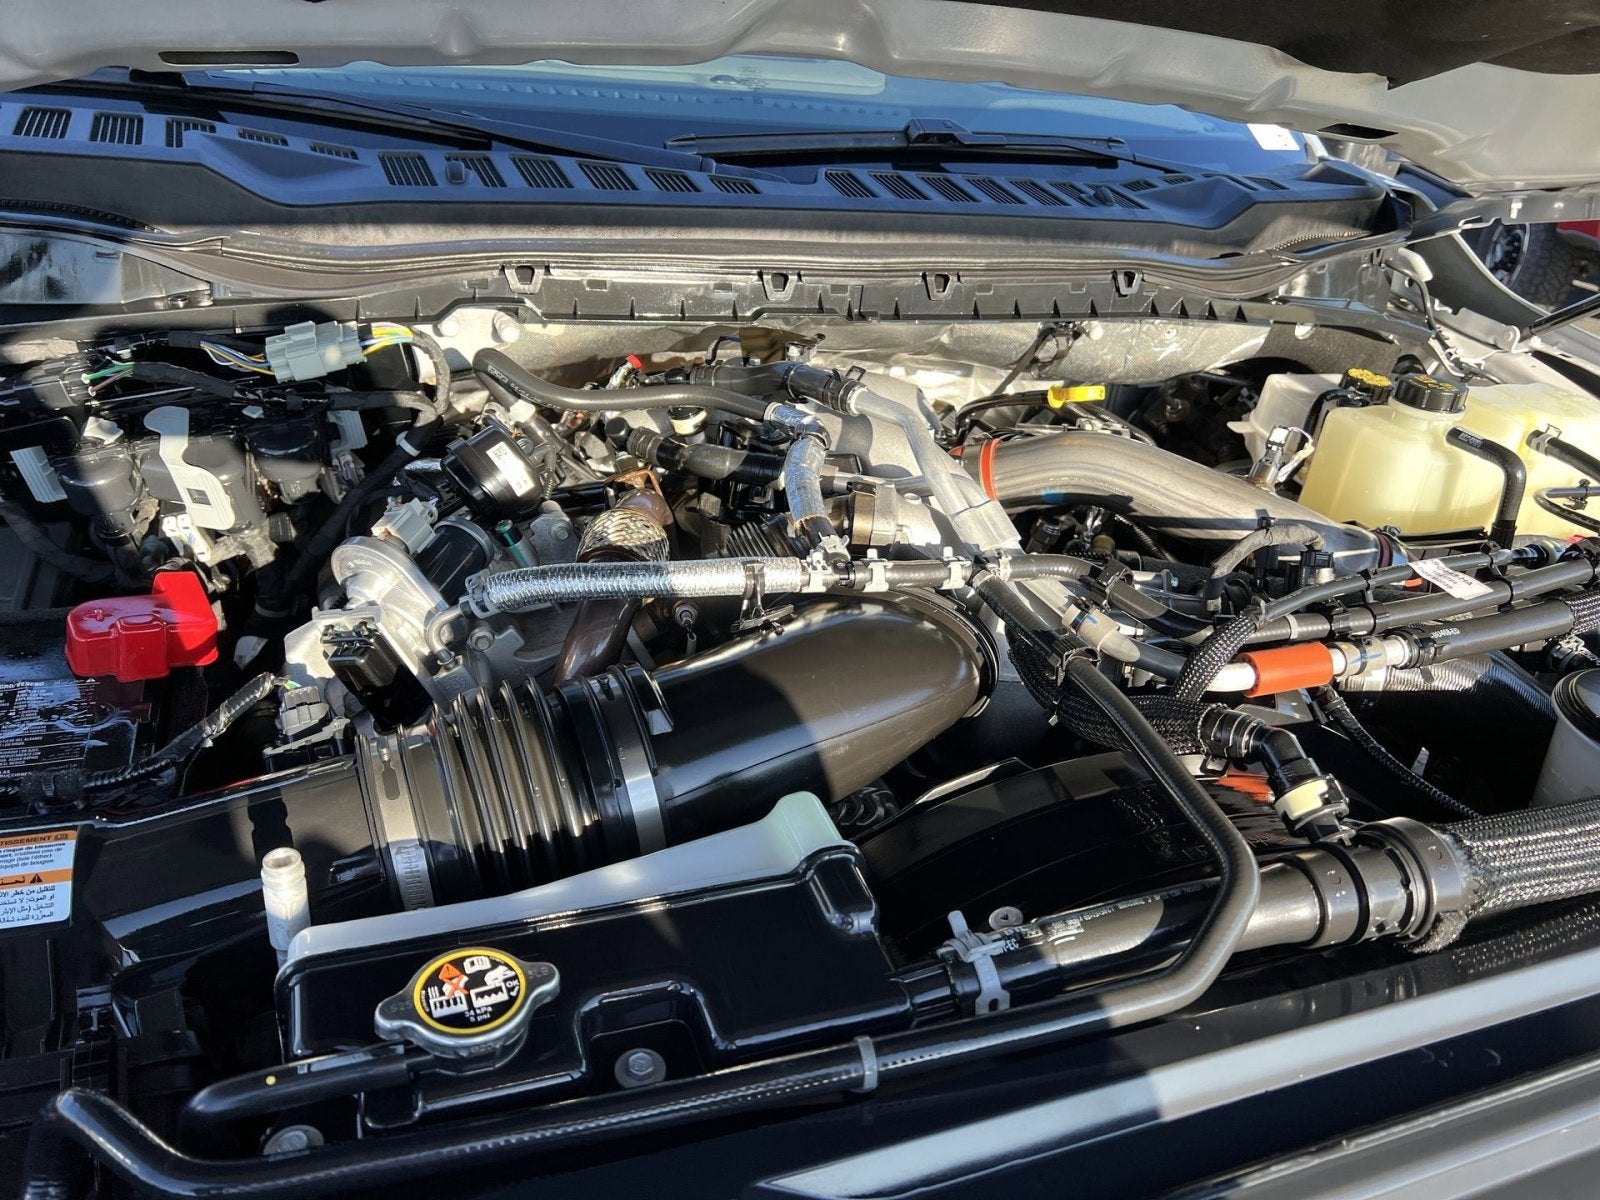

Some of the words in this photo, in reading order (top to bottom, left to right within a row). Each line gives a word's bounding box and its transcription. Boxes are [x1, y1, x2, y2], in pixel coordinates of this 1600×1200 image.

[506, 979, 519, 988] OK
[476, 1005, 492, 1014] kPa
[477, 1013, 491, 1021] psi
